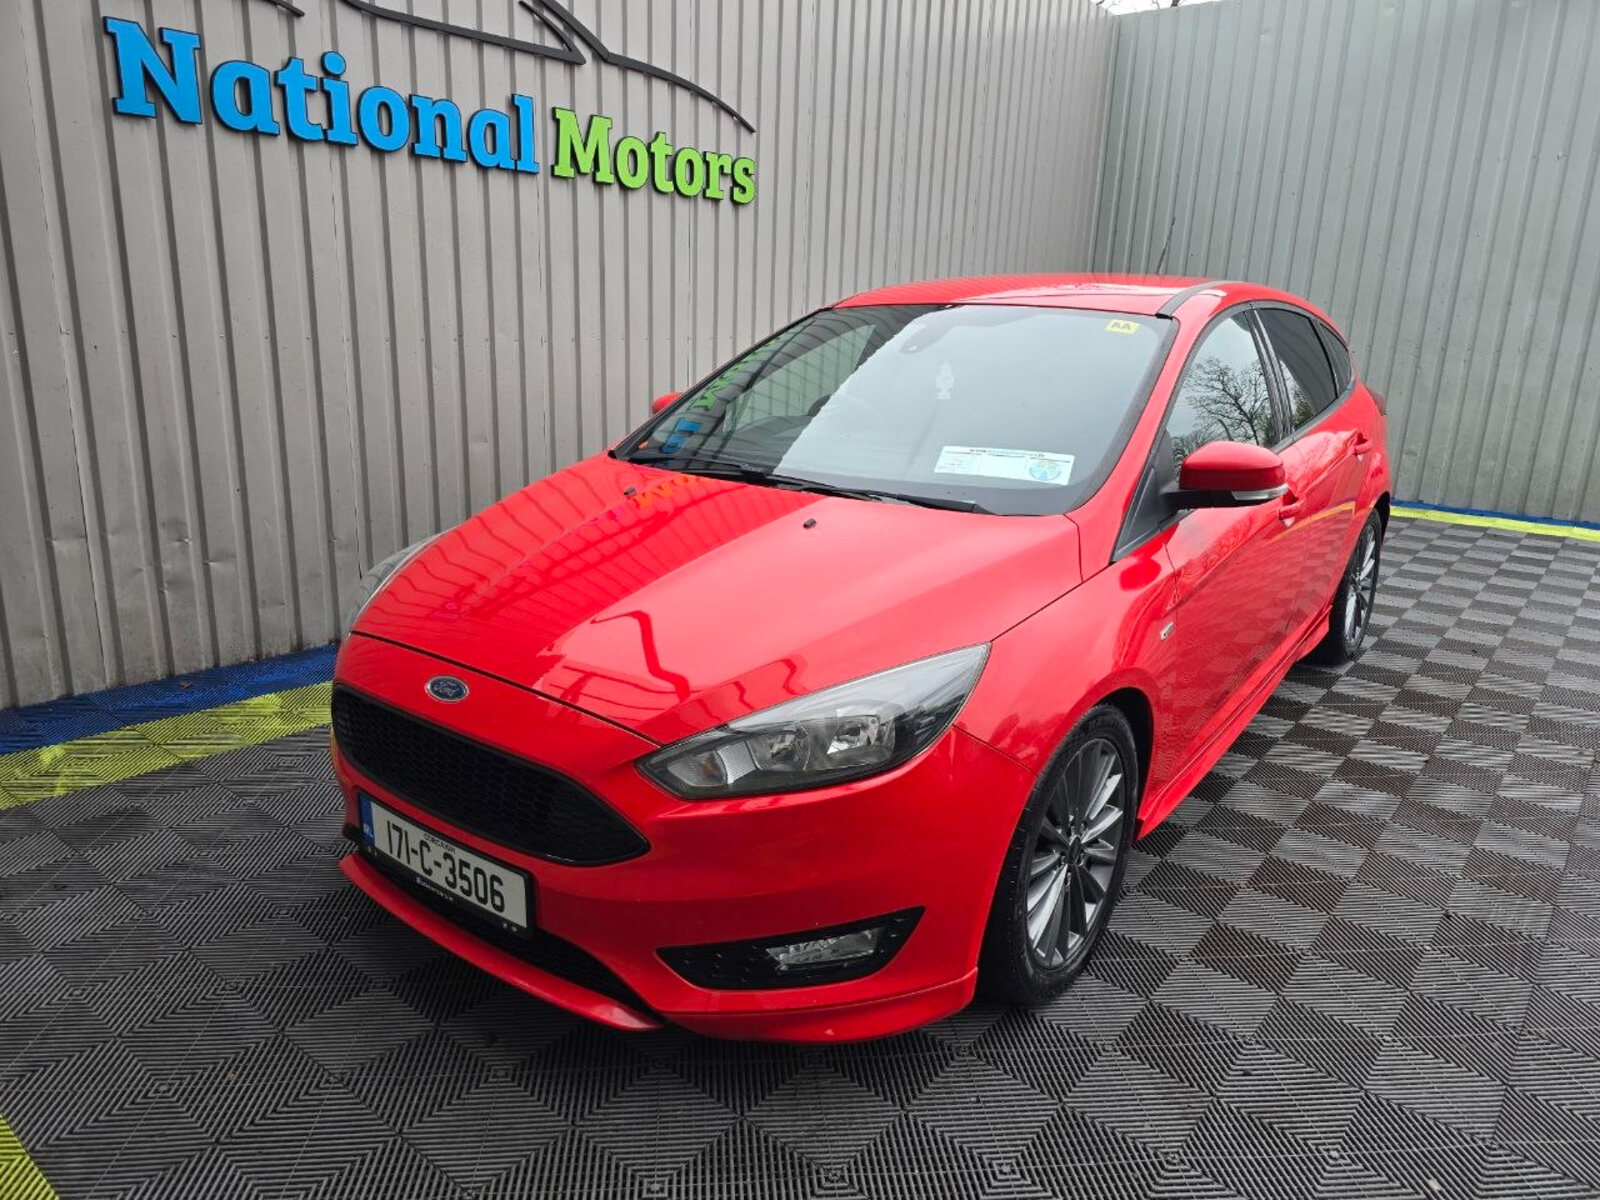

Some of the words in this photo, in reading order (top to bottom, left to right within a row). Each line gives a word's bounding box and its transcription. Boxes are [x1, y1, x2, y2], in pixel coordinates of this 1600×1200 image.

[103, 16, 540, 174] National
[550, 106, 757, 206] Motors
[386, 820, 505, 913] 171-C-3506
